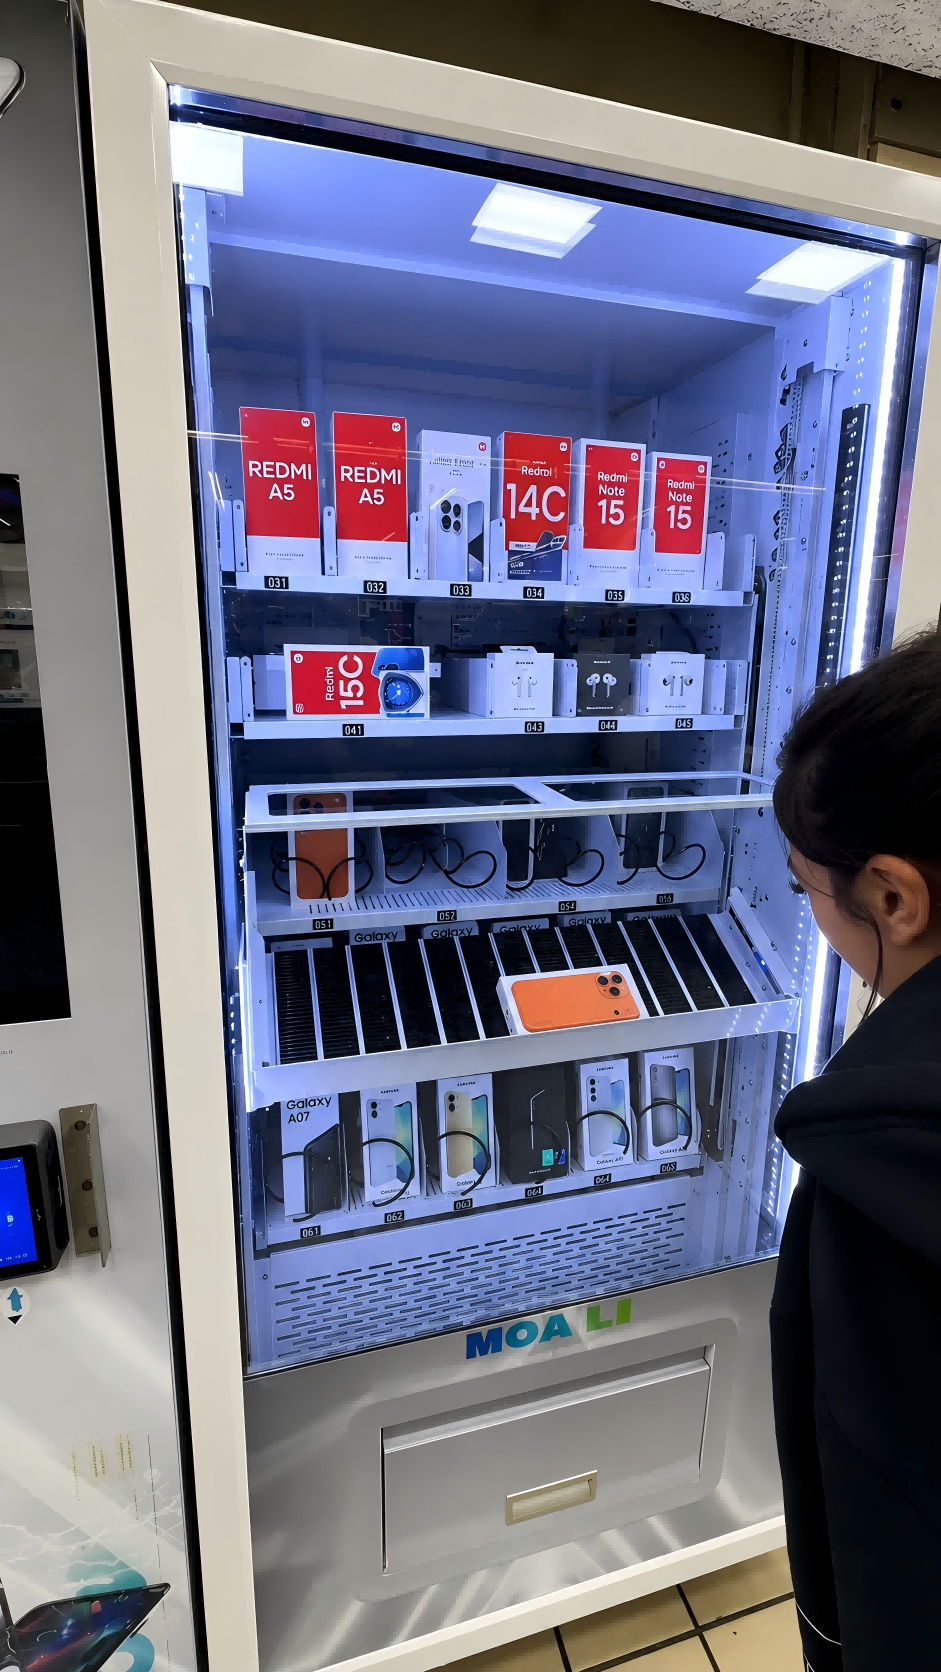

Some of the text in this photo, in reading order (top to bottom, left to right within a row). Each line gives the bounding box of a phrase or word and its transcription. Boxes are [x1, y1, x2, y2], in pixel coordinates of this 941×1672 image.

[248, 460, 312, 480] REDMI
[340, 465, 402, 485] REDMI
[597, 471, 628, 484] Redmi
[598, 484, 625, 497] Note
[667, 479, 695, 490] Redmi
[268, 483, 295, 501] A5
[358, 488, 385, 505] A5
[668, 491, 693, 503] Note
[506, 483, 567, 523] 14C
[597, 499, 625, 526] 15
[666, 505, 693, 530] 15
[268, 578, 287, 588] 031
[366, 582, 384, 593] 032
[452, 586, 470, 596] 033
[526, 588, 542, 598] 034
[338, 654, 364, 710] 15C
[344, 725, 362, 735] 041
[526, 722, 543, 732] 043
[439, 911, 455, 921] 052
[315, 920, 332, 929] 051
[354, 930, 399, 943] Galaxy
[431, 926, 473, 939] Galaxy
[286, 1095, 332, 1111] Galaxy
[287, 1111, 310, 1124] A07
[386, 1211, 403, 1222] 062
[302, 1227, 319, 1238] 061
[466, 1298, 632, 1360] MOA LI
